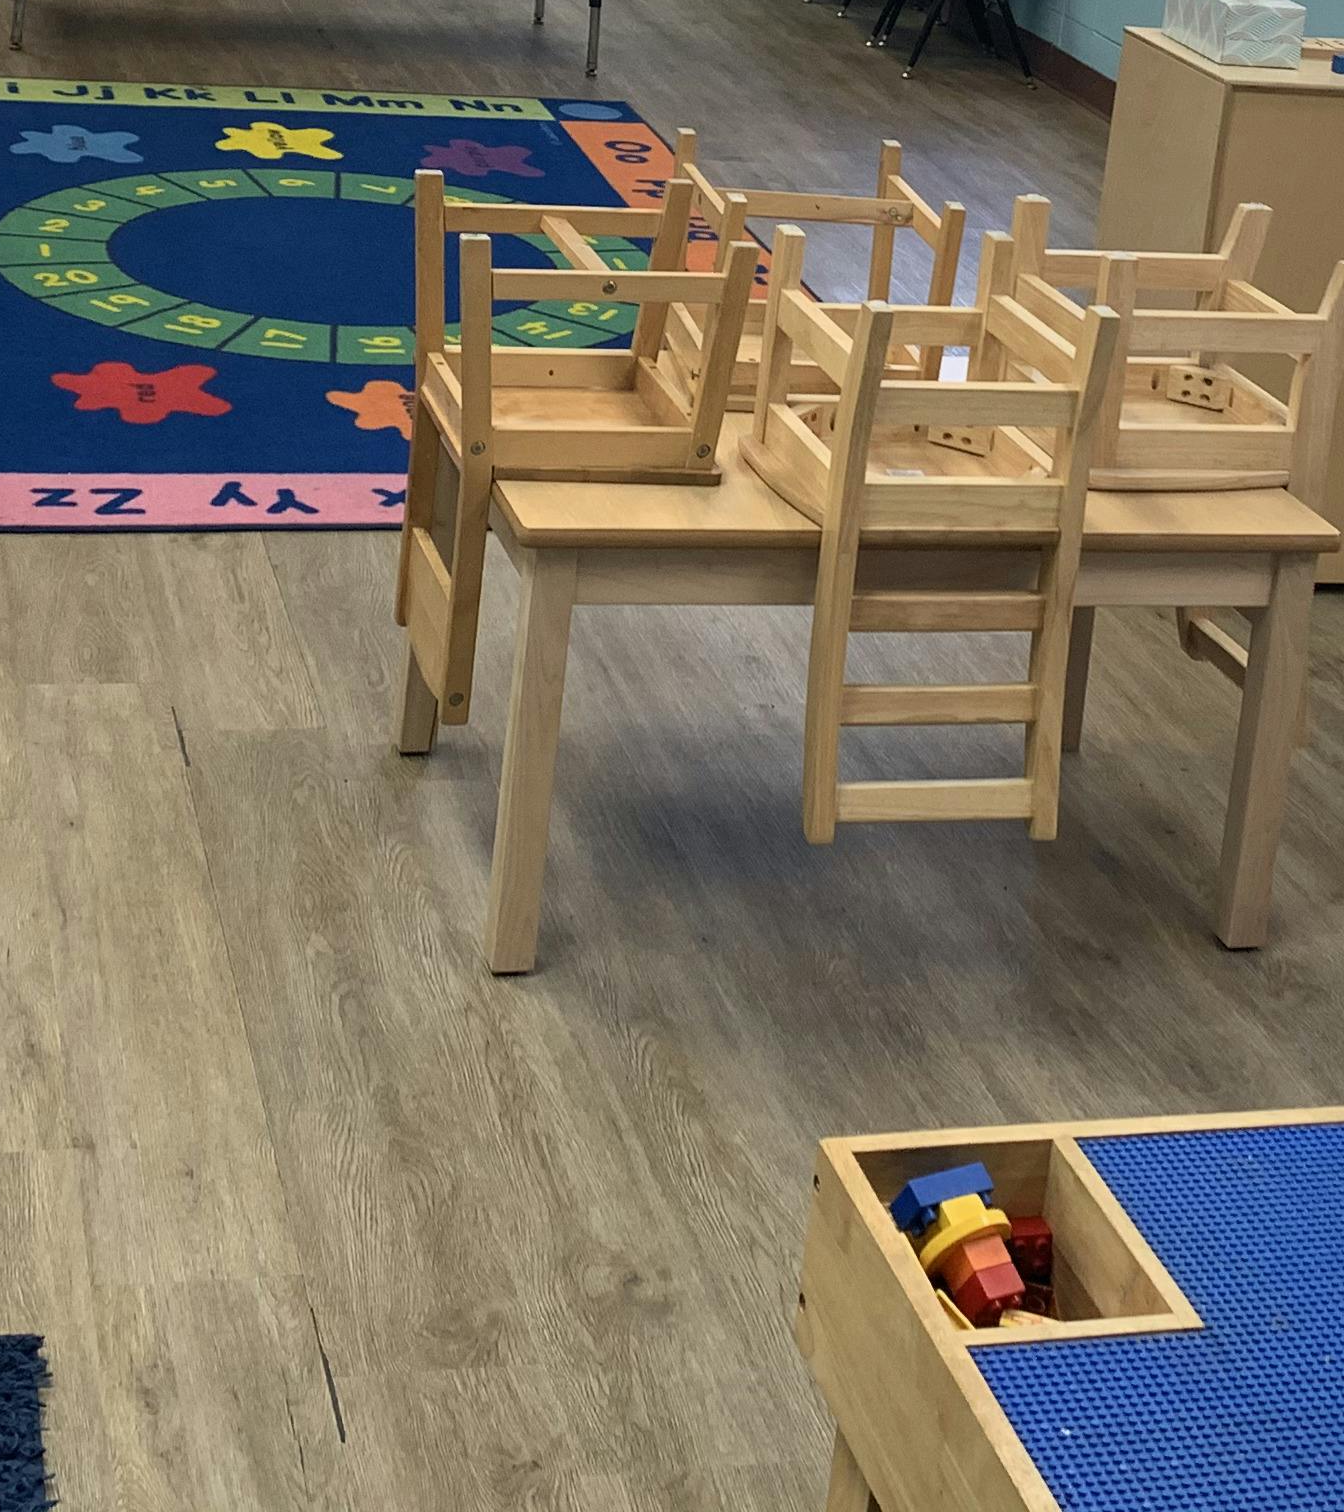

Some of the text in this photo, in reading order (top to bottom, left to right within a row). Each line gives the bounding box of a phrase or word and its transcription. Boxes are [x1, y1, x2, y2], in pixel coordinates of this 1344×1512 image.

[52, 84, 116, 101] Jj
[143, 86, 218, 102] Kk
[321, 93, 425, 110] Mm
[449, 98, 524, 113] Nn
[267, 128, 294, 151] yellow
[604, 140, 653, 164] Oo
[73, 199, 106, 212] 3
[38, 218, 70, 233] 2
[39, 243, 52, 258] 1
[33, 268, 99, 287] 20
[89, 293, 151, 312] 19
[567, 302, 619, 321] 13
[164, 314, 222, 335] 18
[516, 320, 573, 340] 14
[260, 328, 308, 349] 17
[357, 335, 407, 355] 16
[129, 383, 157, 403] red
[29, 487, 148, 516] Zz
[210, 481, 321, 515] Yy
